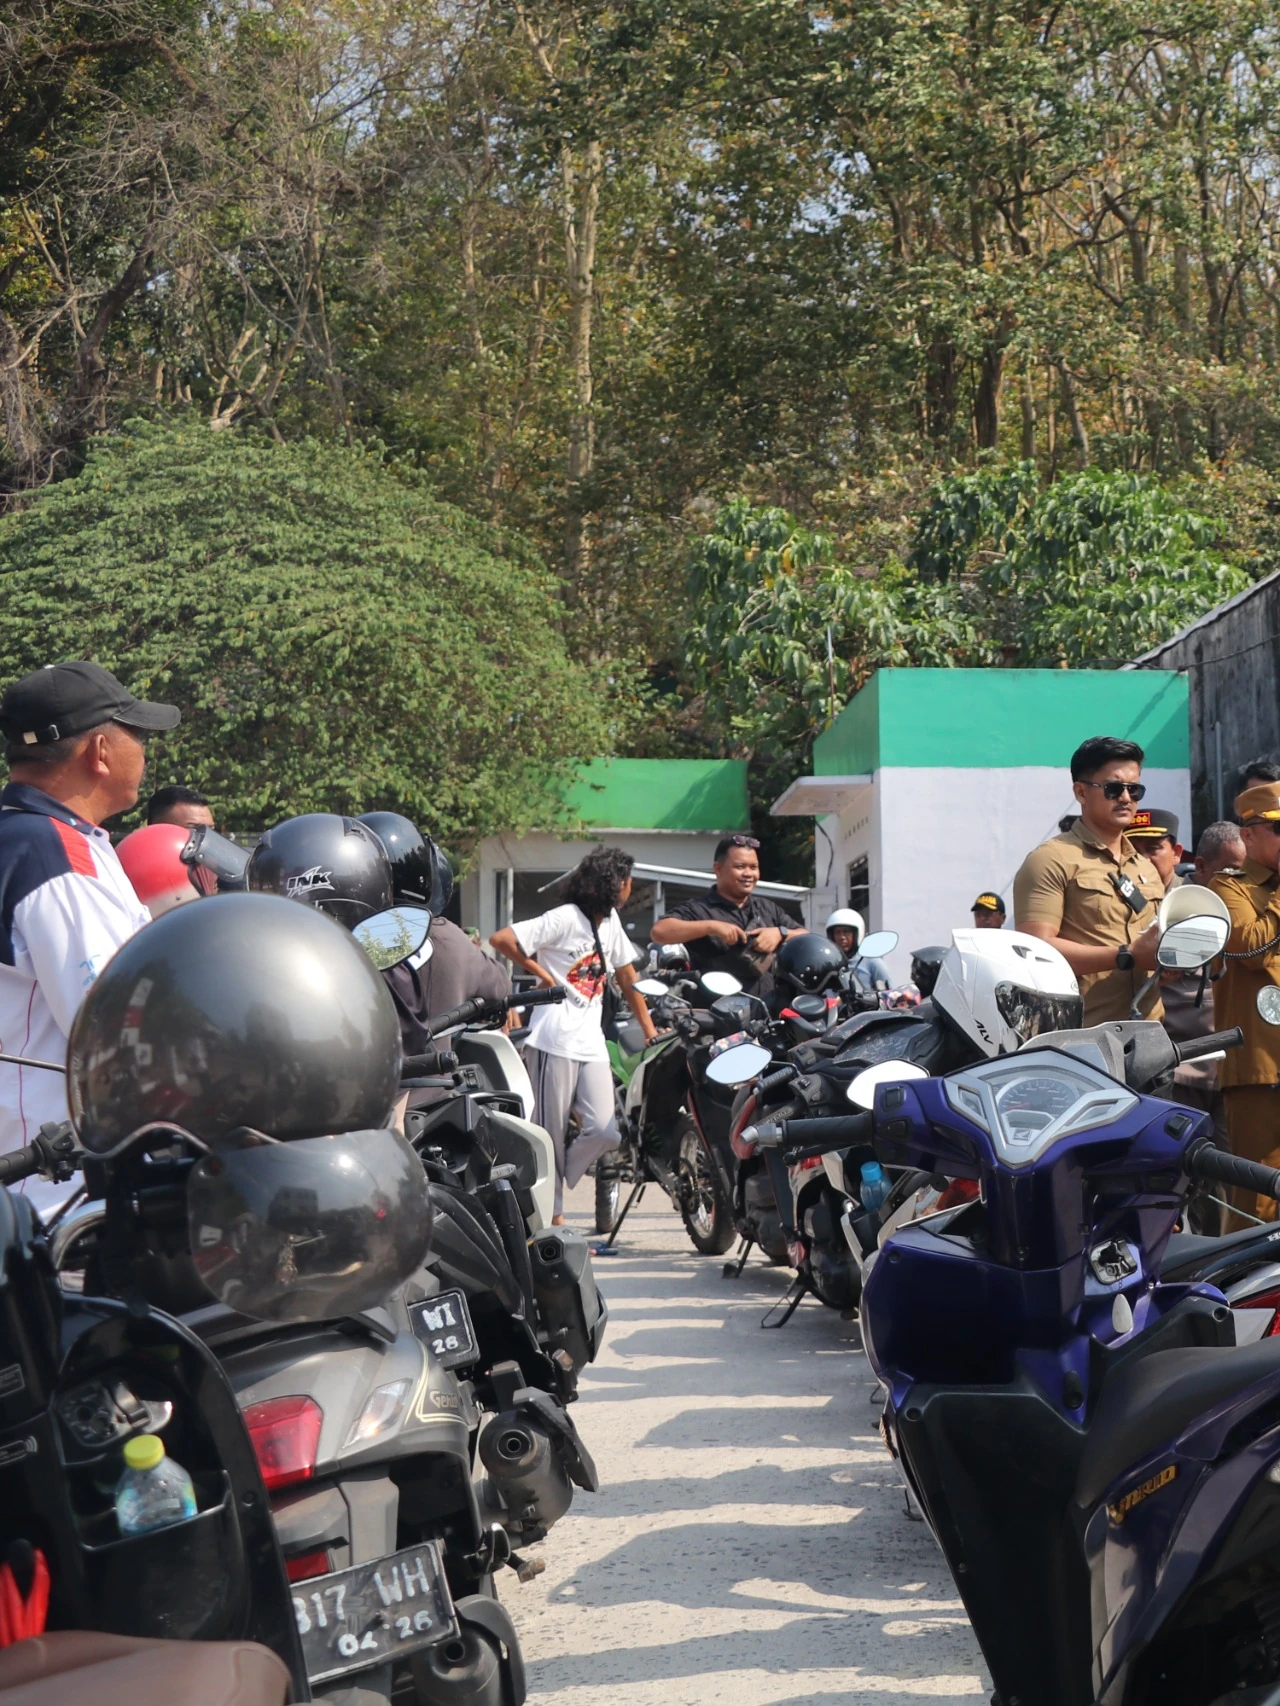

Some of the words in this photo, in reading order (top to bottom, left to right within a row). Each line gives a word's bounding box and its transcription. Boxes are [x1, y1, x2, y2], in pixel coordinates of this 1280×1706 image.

[287, 870, 333, 892] INK
[568, 943, 589, 960] THE
[432, 1335, 459, 1354] 28
[373, 1557, 430, 1607] WH
